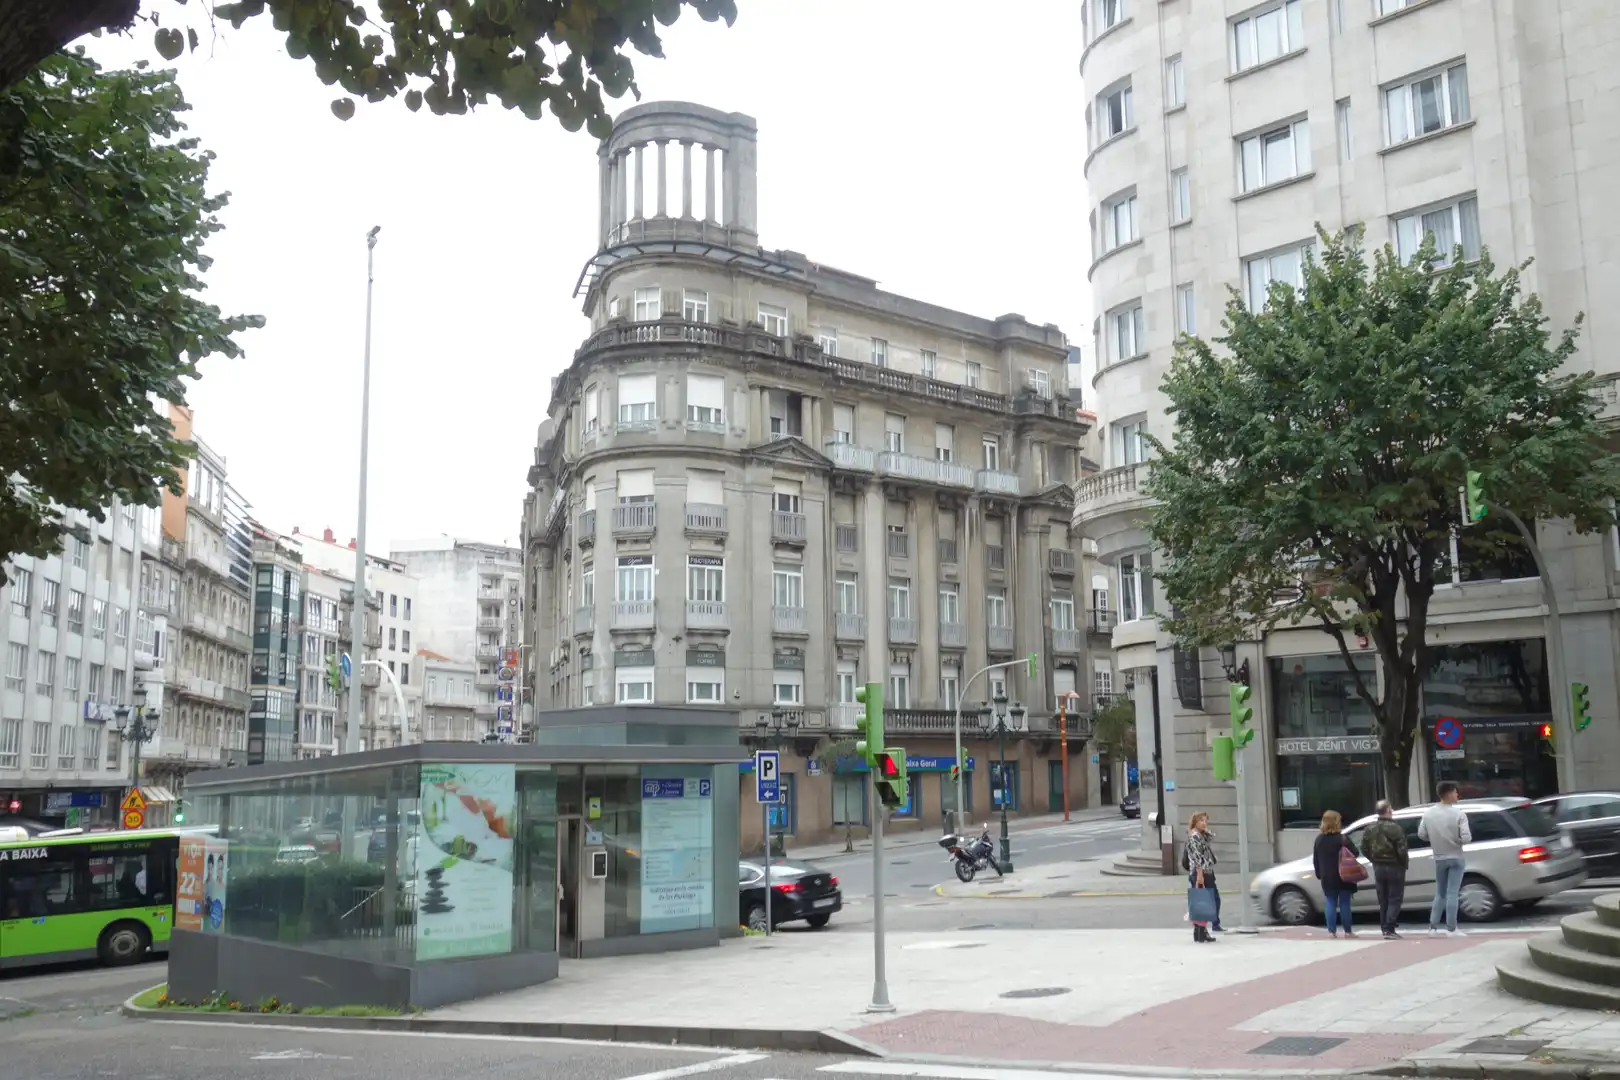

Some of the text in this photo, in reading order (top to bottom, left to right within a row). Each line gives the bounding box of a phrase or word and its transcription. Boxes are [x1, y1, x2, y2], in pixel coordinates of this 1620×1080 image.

[509, 585, 517, 645] HOTEL
[1279, 739, 1380, 752] HOTEL ZENIT VIGO
[763, 760, 773, 777] P
[905, 759, 937, 768] aixa Geral
[700, 782, 709, 794] P
[127, 815, 140, 824] 30
[12, 847, 48, 860] BAIXA
[180, 872, 196, 895] 22
